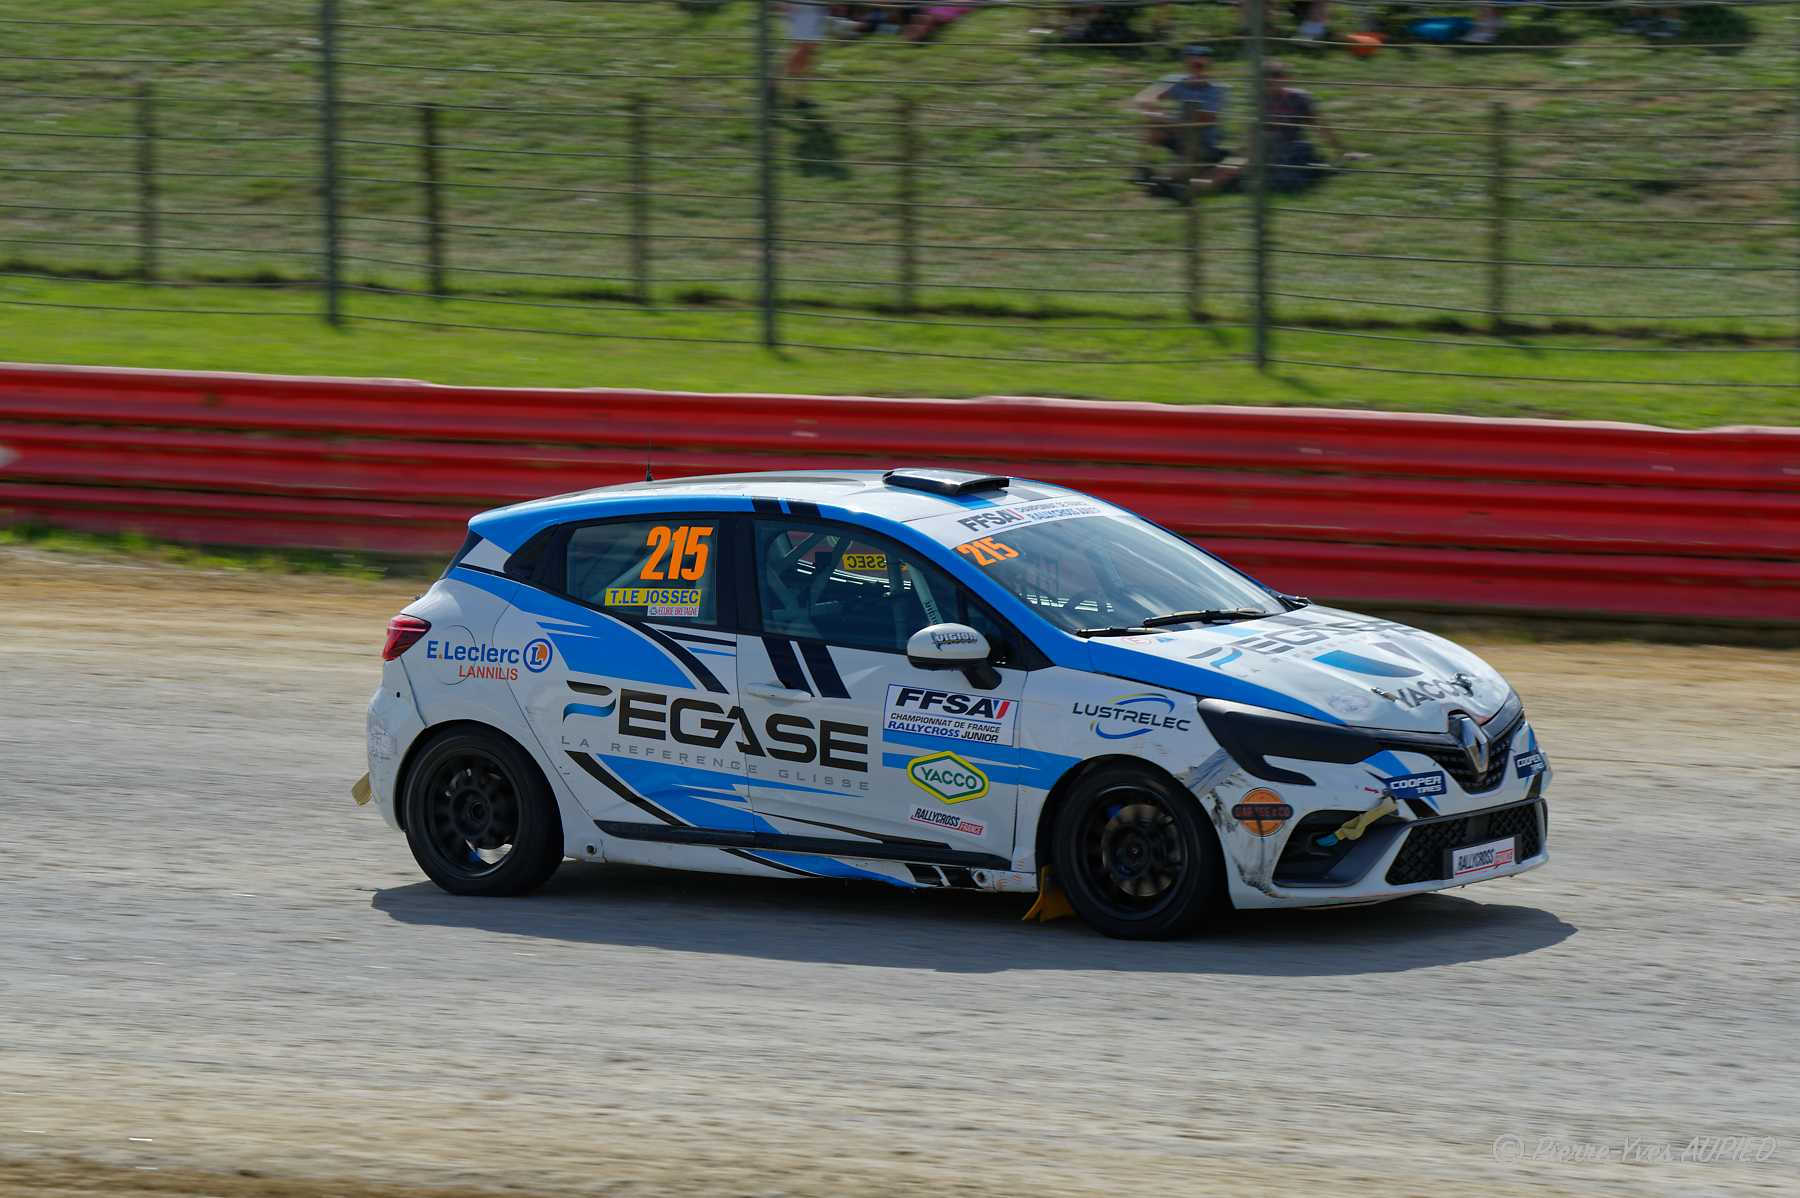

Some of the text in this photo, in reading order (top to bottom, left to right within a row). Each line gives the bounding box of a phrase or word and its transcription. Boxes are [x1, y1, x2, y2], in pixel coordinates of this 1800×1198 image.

[957, 509, 1018, 532] FFSA
[640, 526, 714, 581] 215
[956, 536, 1020, 566] 215
[610, 590, 699, 604] T.LE JOSSEC
[427, 640, 520, 663] E.Leclerc
[459, 665, 519, 680] LANNILIS
[896, 688, 994, 719] FFSA
[562, 680, 868, 773] PEGASE
[890, 713, 1000, 734] CHAMPIONNAT DE FRANCE
[1072, 702, 1192, 732] LUSTRELEC
[888, 721, 999, 743] RALLYCROSS JUNIOR
[561, 735, 871, 792] LA REFERENCE GLISSE
[921, 767, 977, 790] YACCO
[1389, 775, 1442, 790] COOPER
[914, 808, 960, 827] RALLYCROSS
